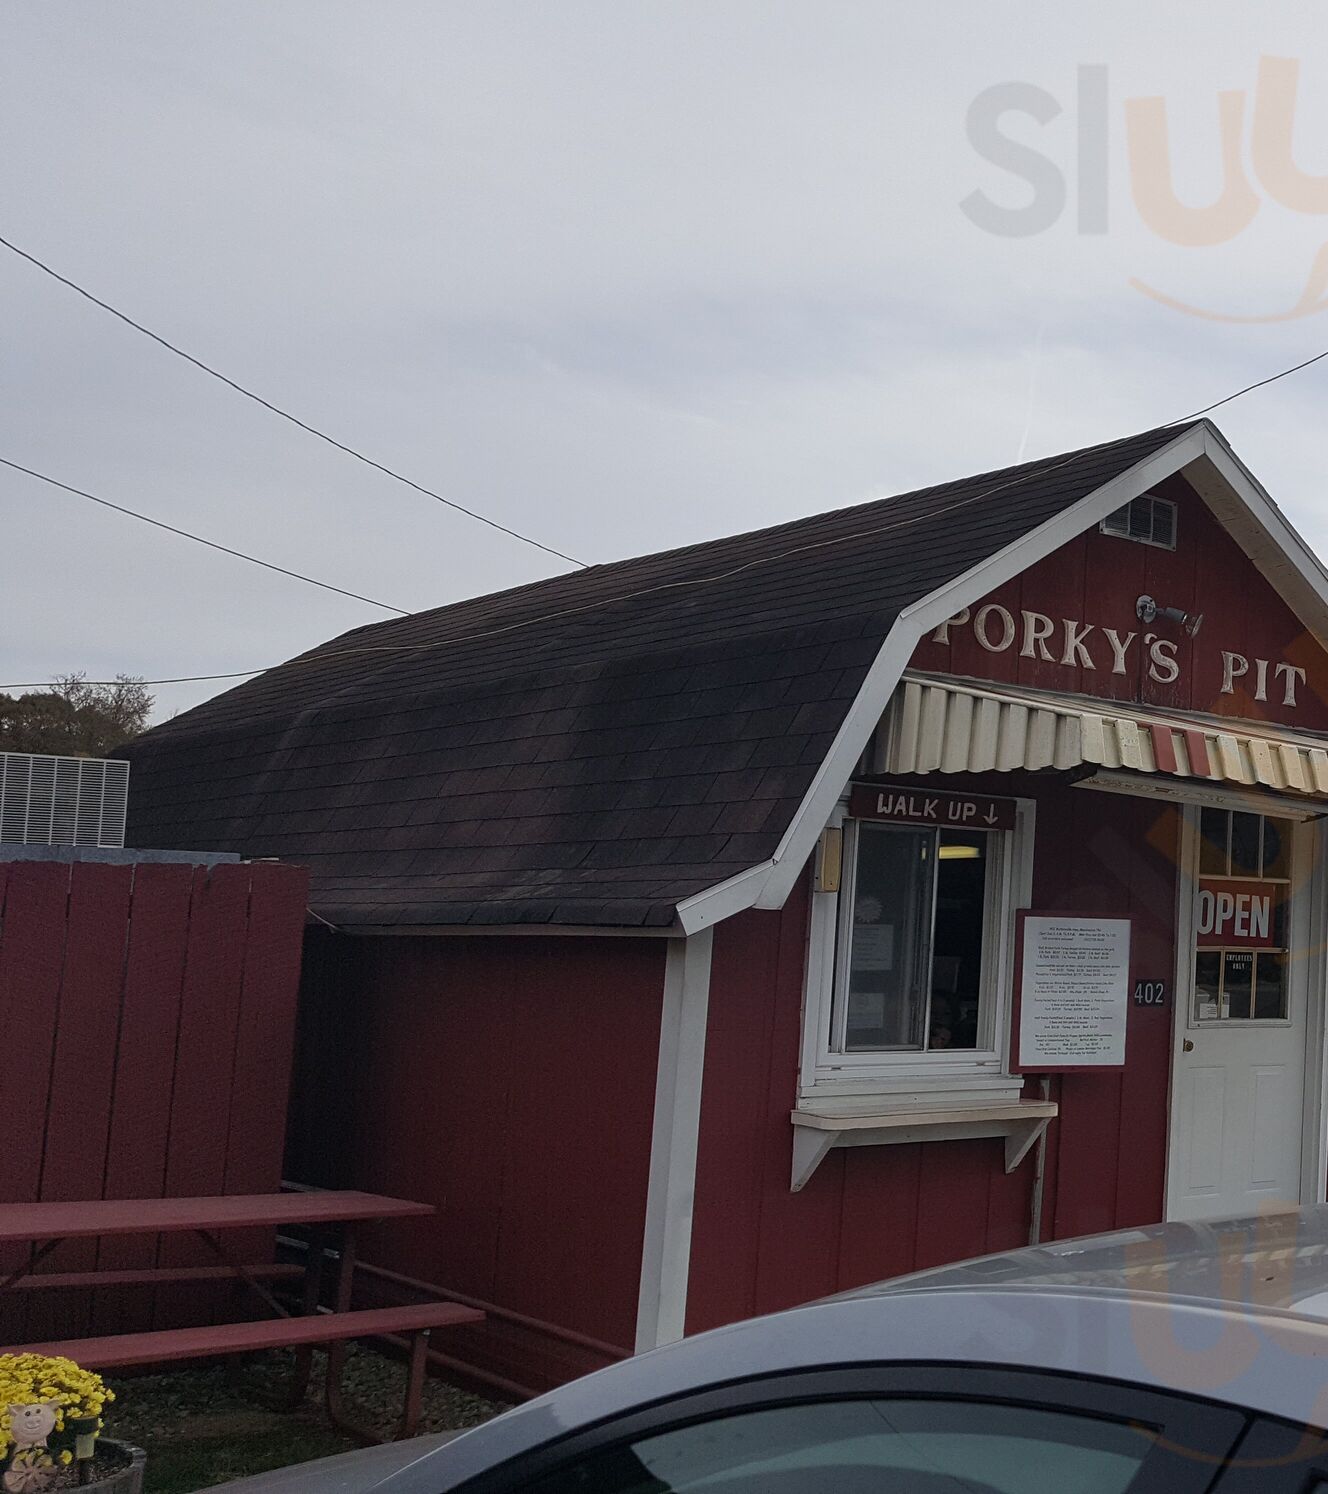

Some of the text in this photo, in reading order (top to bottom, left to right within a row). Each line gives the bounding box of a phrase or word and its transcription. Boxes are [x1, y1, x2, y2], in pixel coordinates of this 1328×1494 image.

[932, 603, 1306, 707] PORKY'S PIT
[877, 793, 977, 821] WALK UP
[1198, 890, 1270, 938] OPEN
[1134, 982, 1164, 1004] 402
